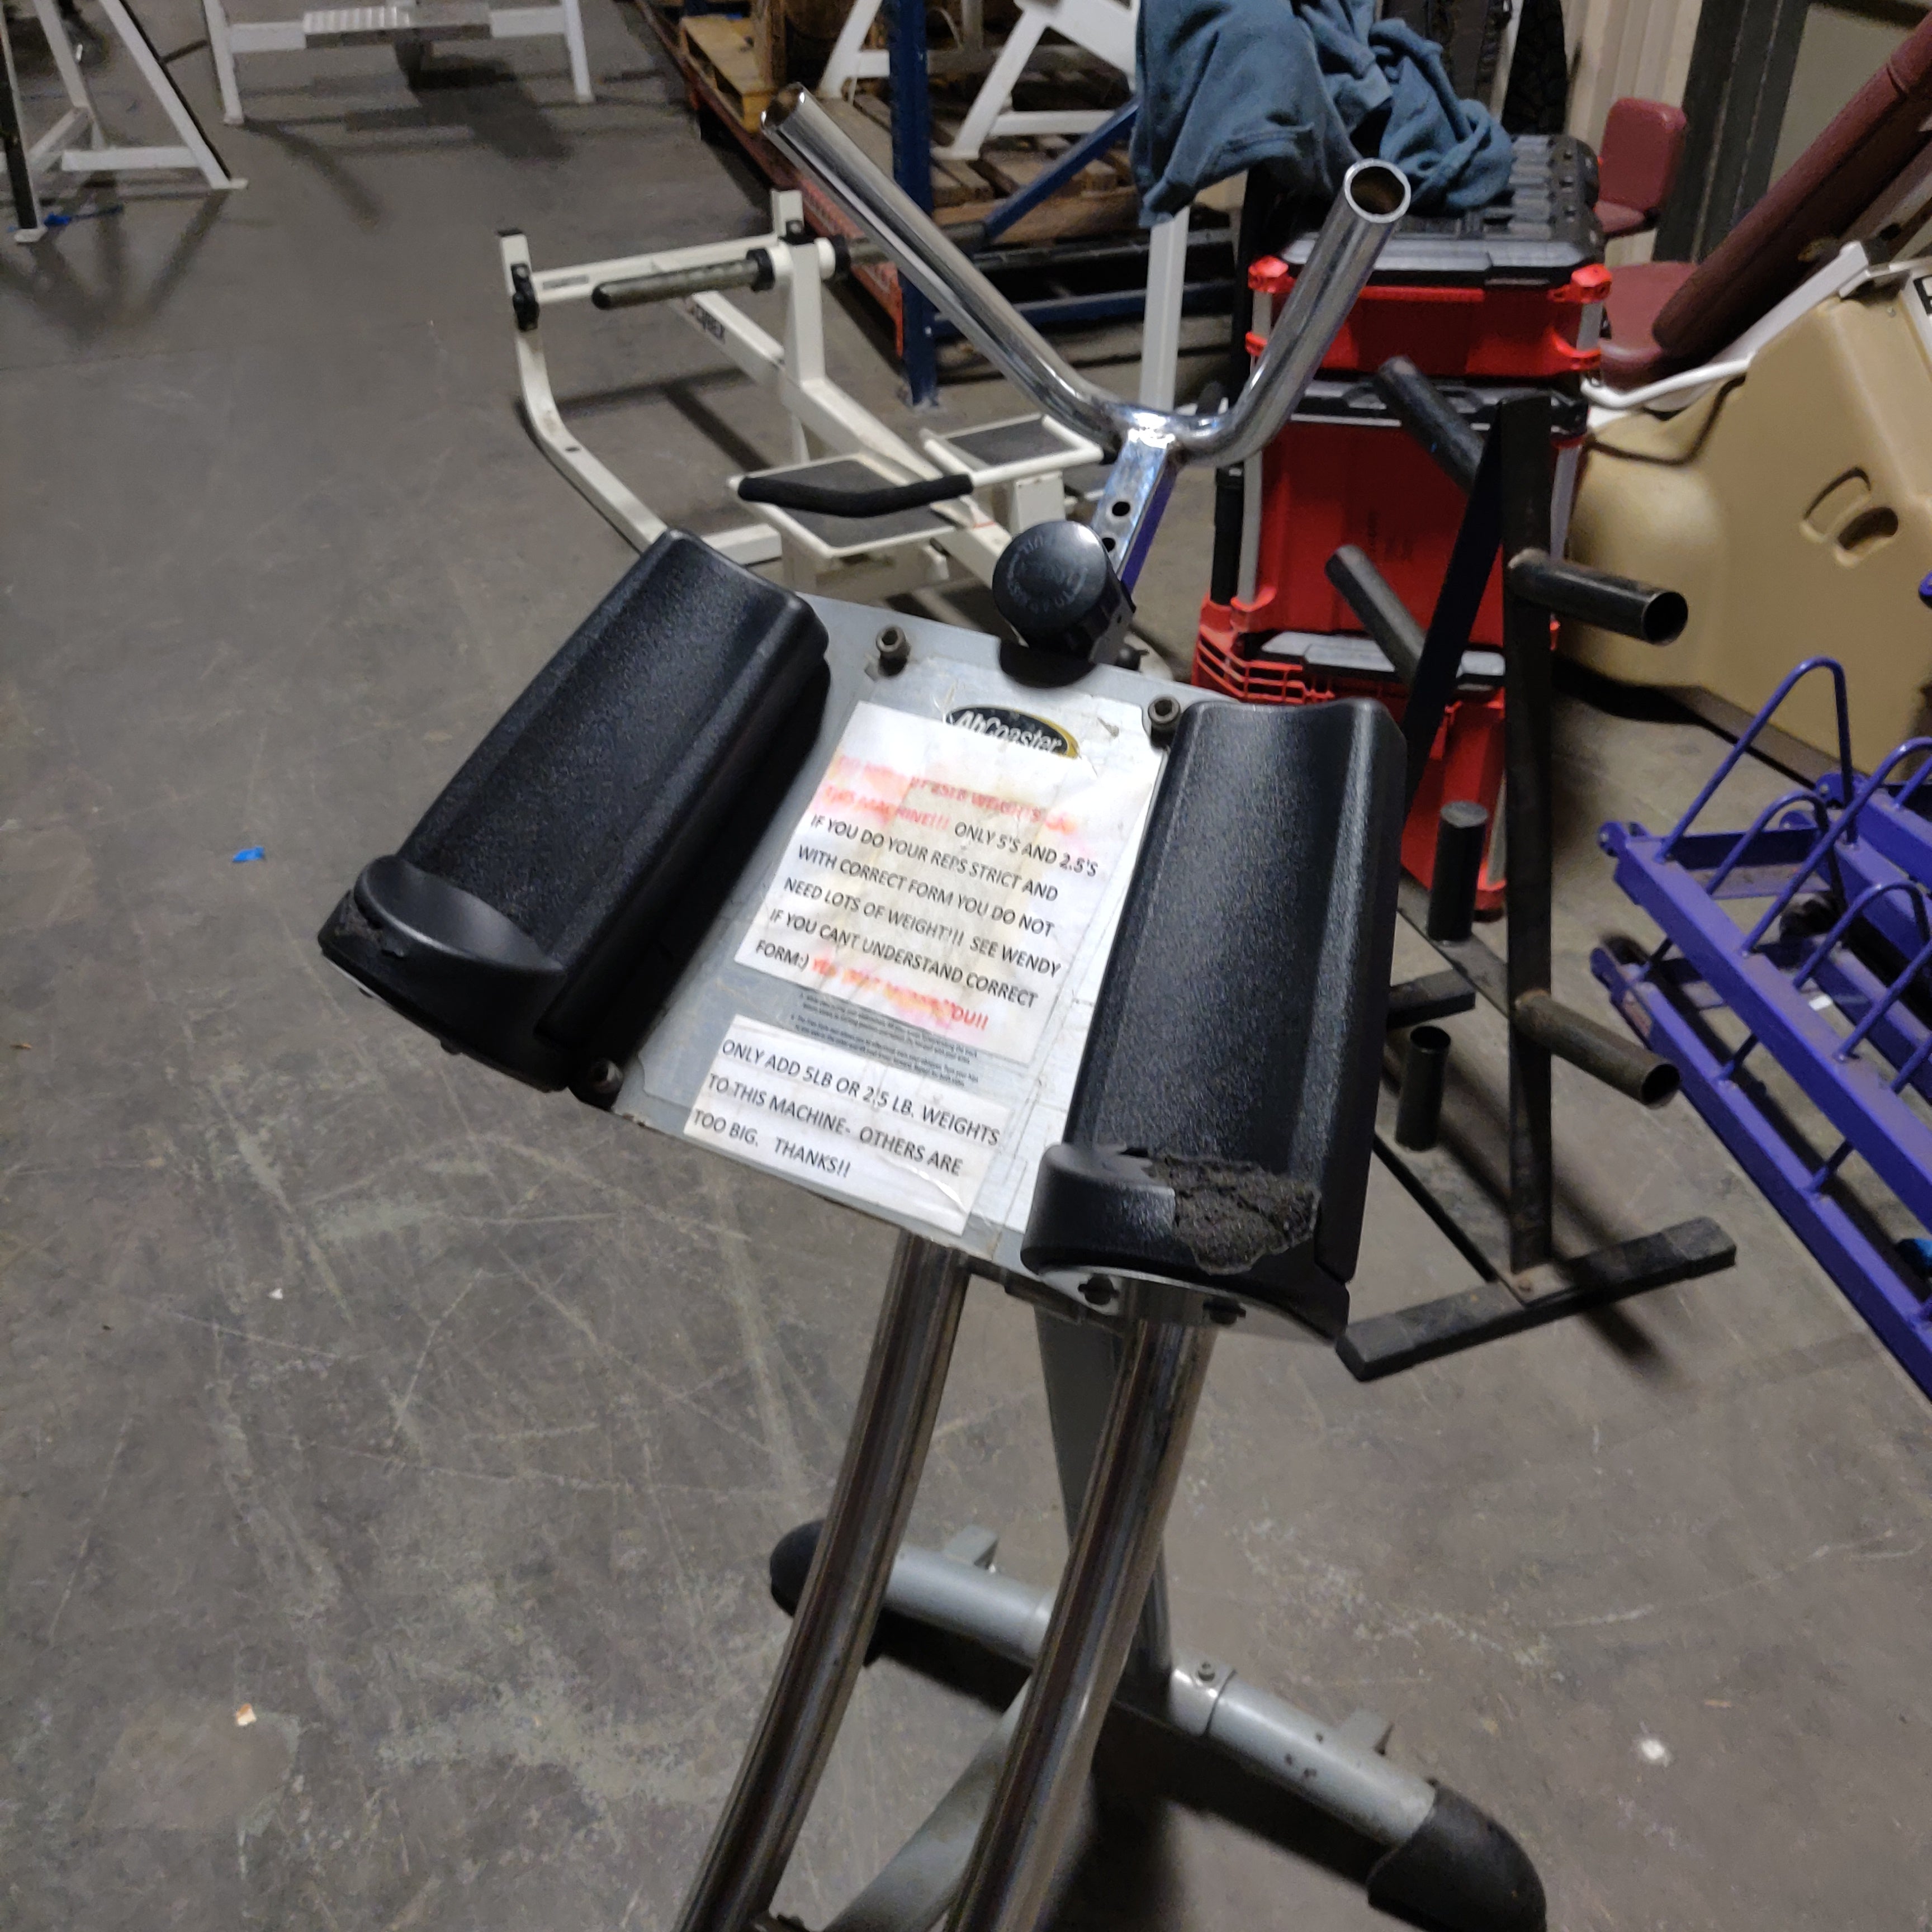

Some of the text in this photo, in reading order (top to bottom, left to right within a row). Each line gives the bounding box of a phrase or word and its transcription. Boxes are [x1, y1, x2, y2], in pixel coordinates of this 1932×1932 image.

[799, 844, 1055, 937] WITH CORRECT FORM YOU DO NOT
[811, 814, 1058, 901] IF YOU DO YOUR REPS STRICT AND
[955, 821, 996, 845] ONLY
[997, 834, 1021, 853] 5'S
[1021, 842, 1057, 864] AND
[1059, 852, 1098, 877] 2.5'S
[770, 908, 784, 922] IF
[786, 912, 817, 934] YOU
[820, 924, 861, 949] CANT
[862, 936, 963, 983] UNDERSTAND
[966, 972, 1039, 1007] CORRECT
[784, 877, 822, 900] NEED
[825, 890, 861, 912] LOTS
[864, 902, 886, 919] OF
[970, 936, 998, 958] SEE
[1002, 944, 1061, 978] WENDY
[708, 1073, 729, 1093] TO
[733, 1081, 767, 1107] THIS
[860, 1125, 925, 1162] OTHERS
[927, 1150, 963, 1177] ARE
[722, 1039, 1000, 1146] ONLY ADD 5LB OR 2.5 LB. WEIGHTS
[693, 1109, 851, 1178] TOO BIG. THANKS!!
